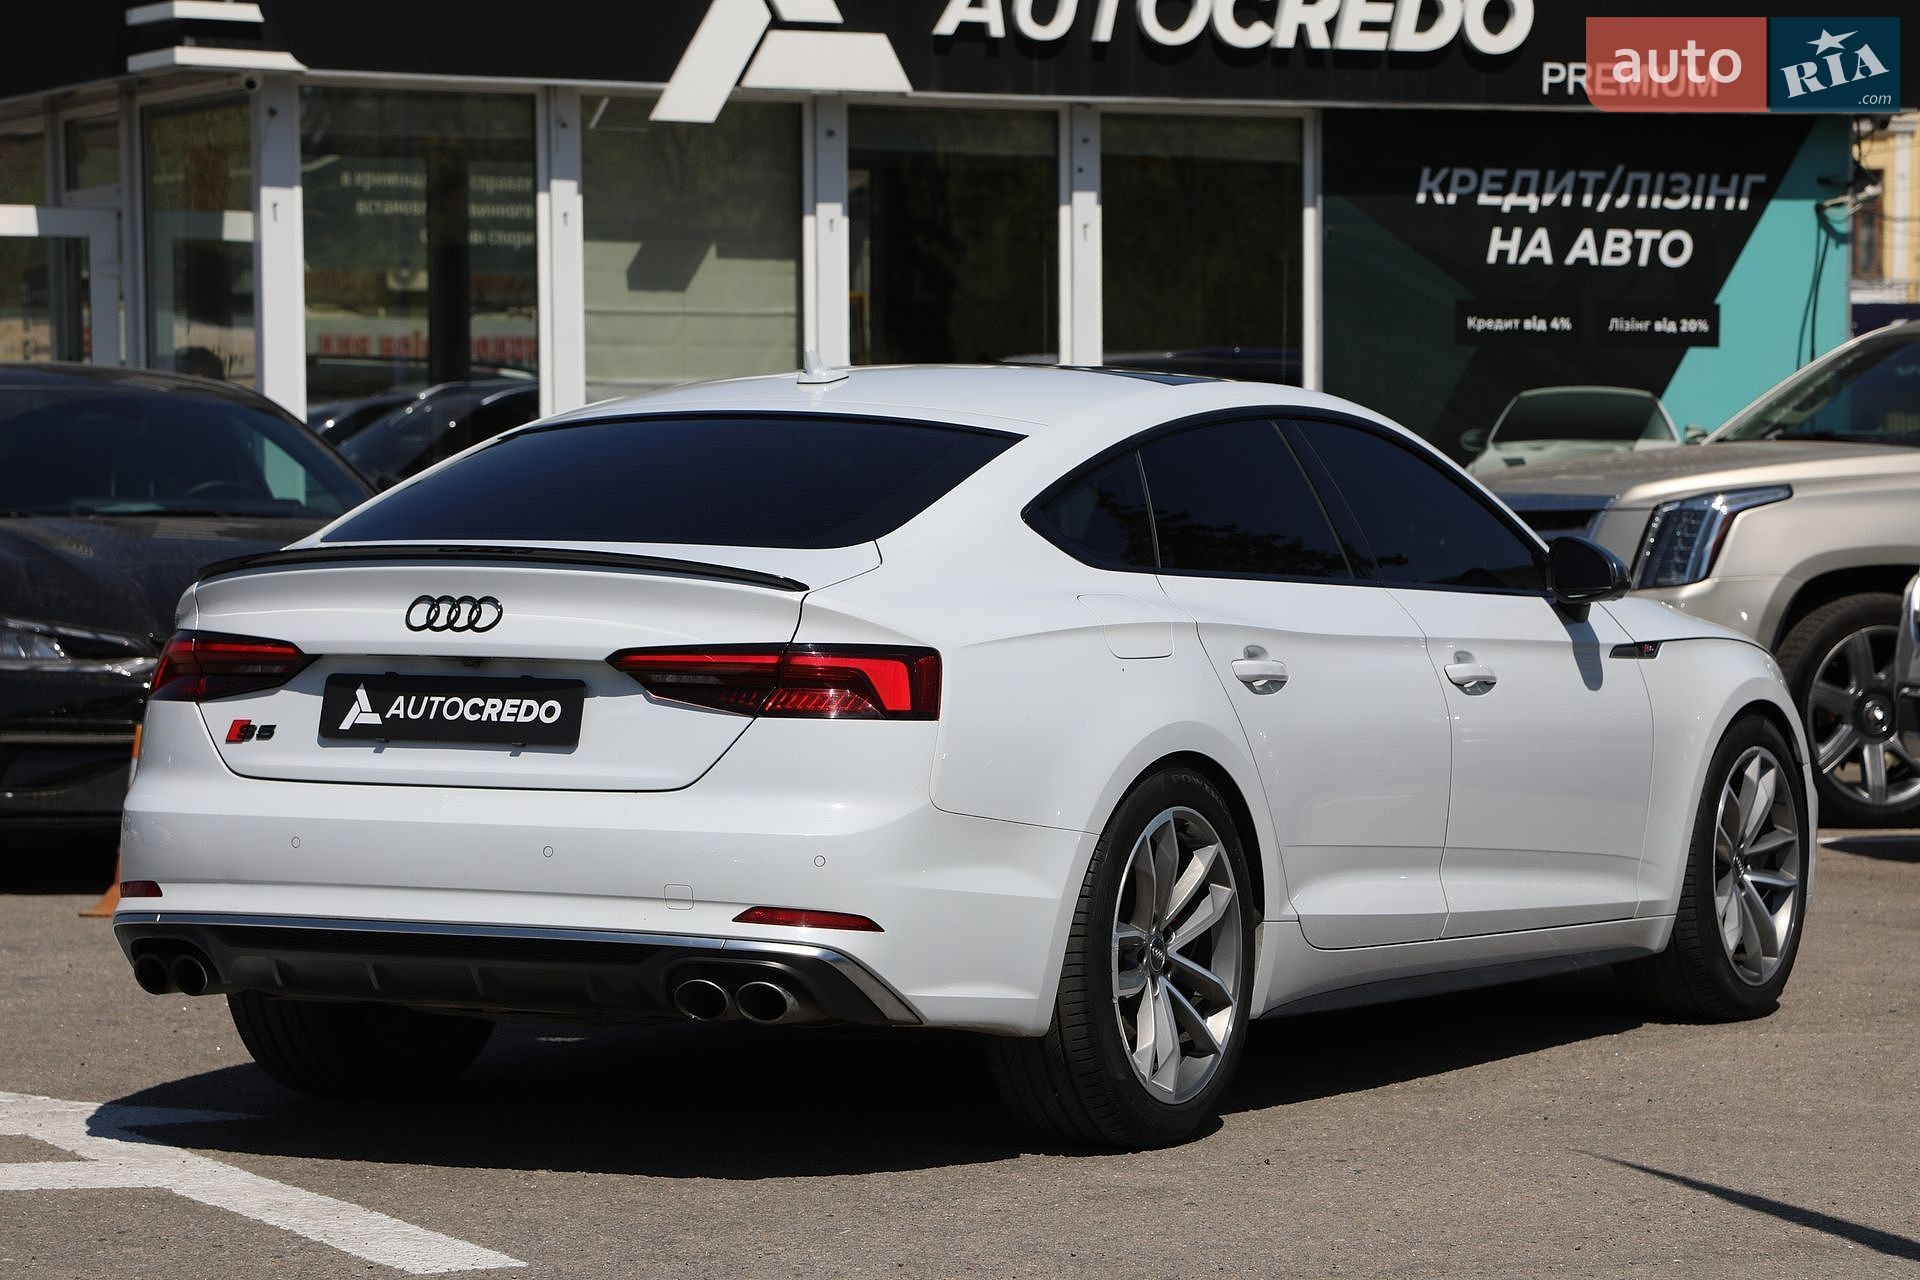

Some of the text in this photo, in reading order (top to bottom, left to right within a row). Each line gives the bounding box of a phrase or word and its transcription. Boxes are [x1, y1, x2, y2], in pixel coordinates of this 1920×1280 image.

[1541, 61, 1719, 98] PREMIUM
[1415, 165, 1766, 213] КРЕДИТ/ЛІЗІНГ
[1486, 227, 1694, 268] НА АВТО
[1467, 315, 1572, 332] Кредит від 4%
[1608, 317, 1709, 333] Лізінг від 20%
[386, 695, 562, 724] AUTOCREDO
